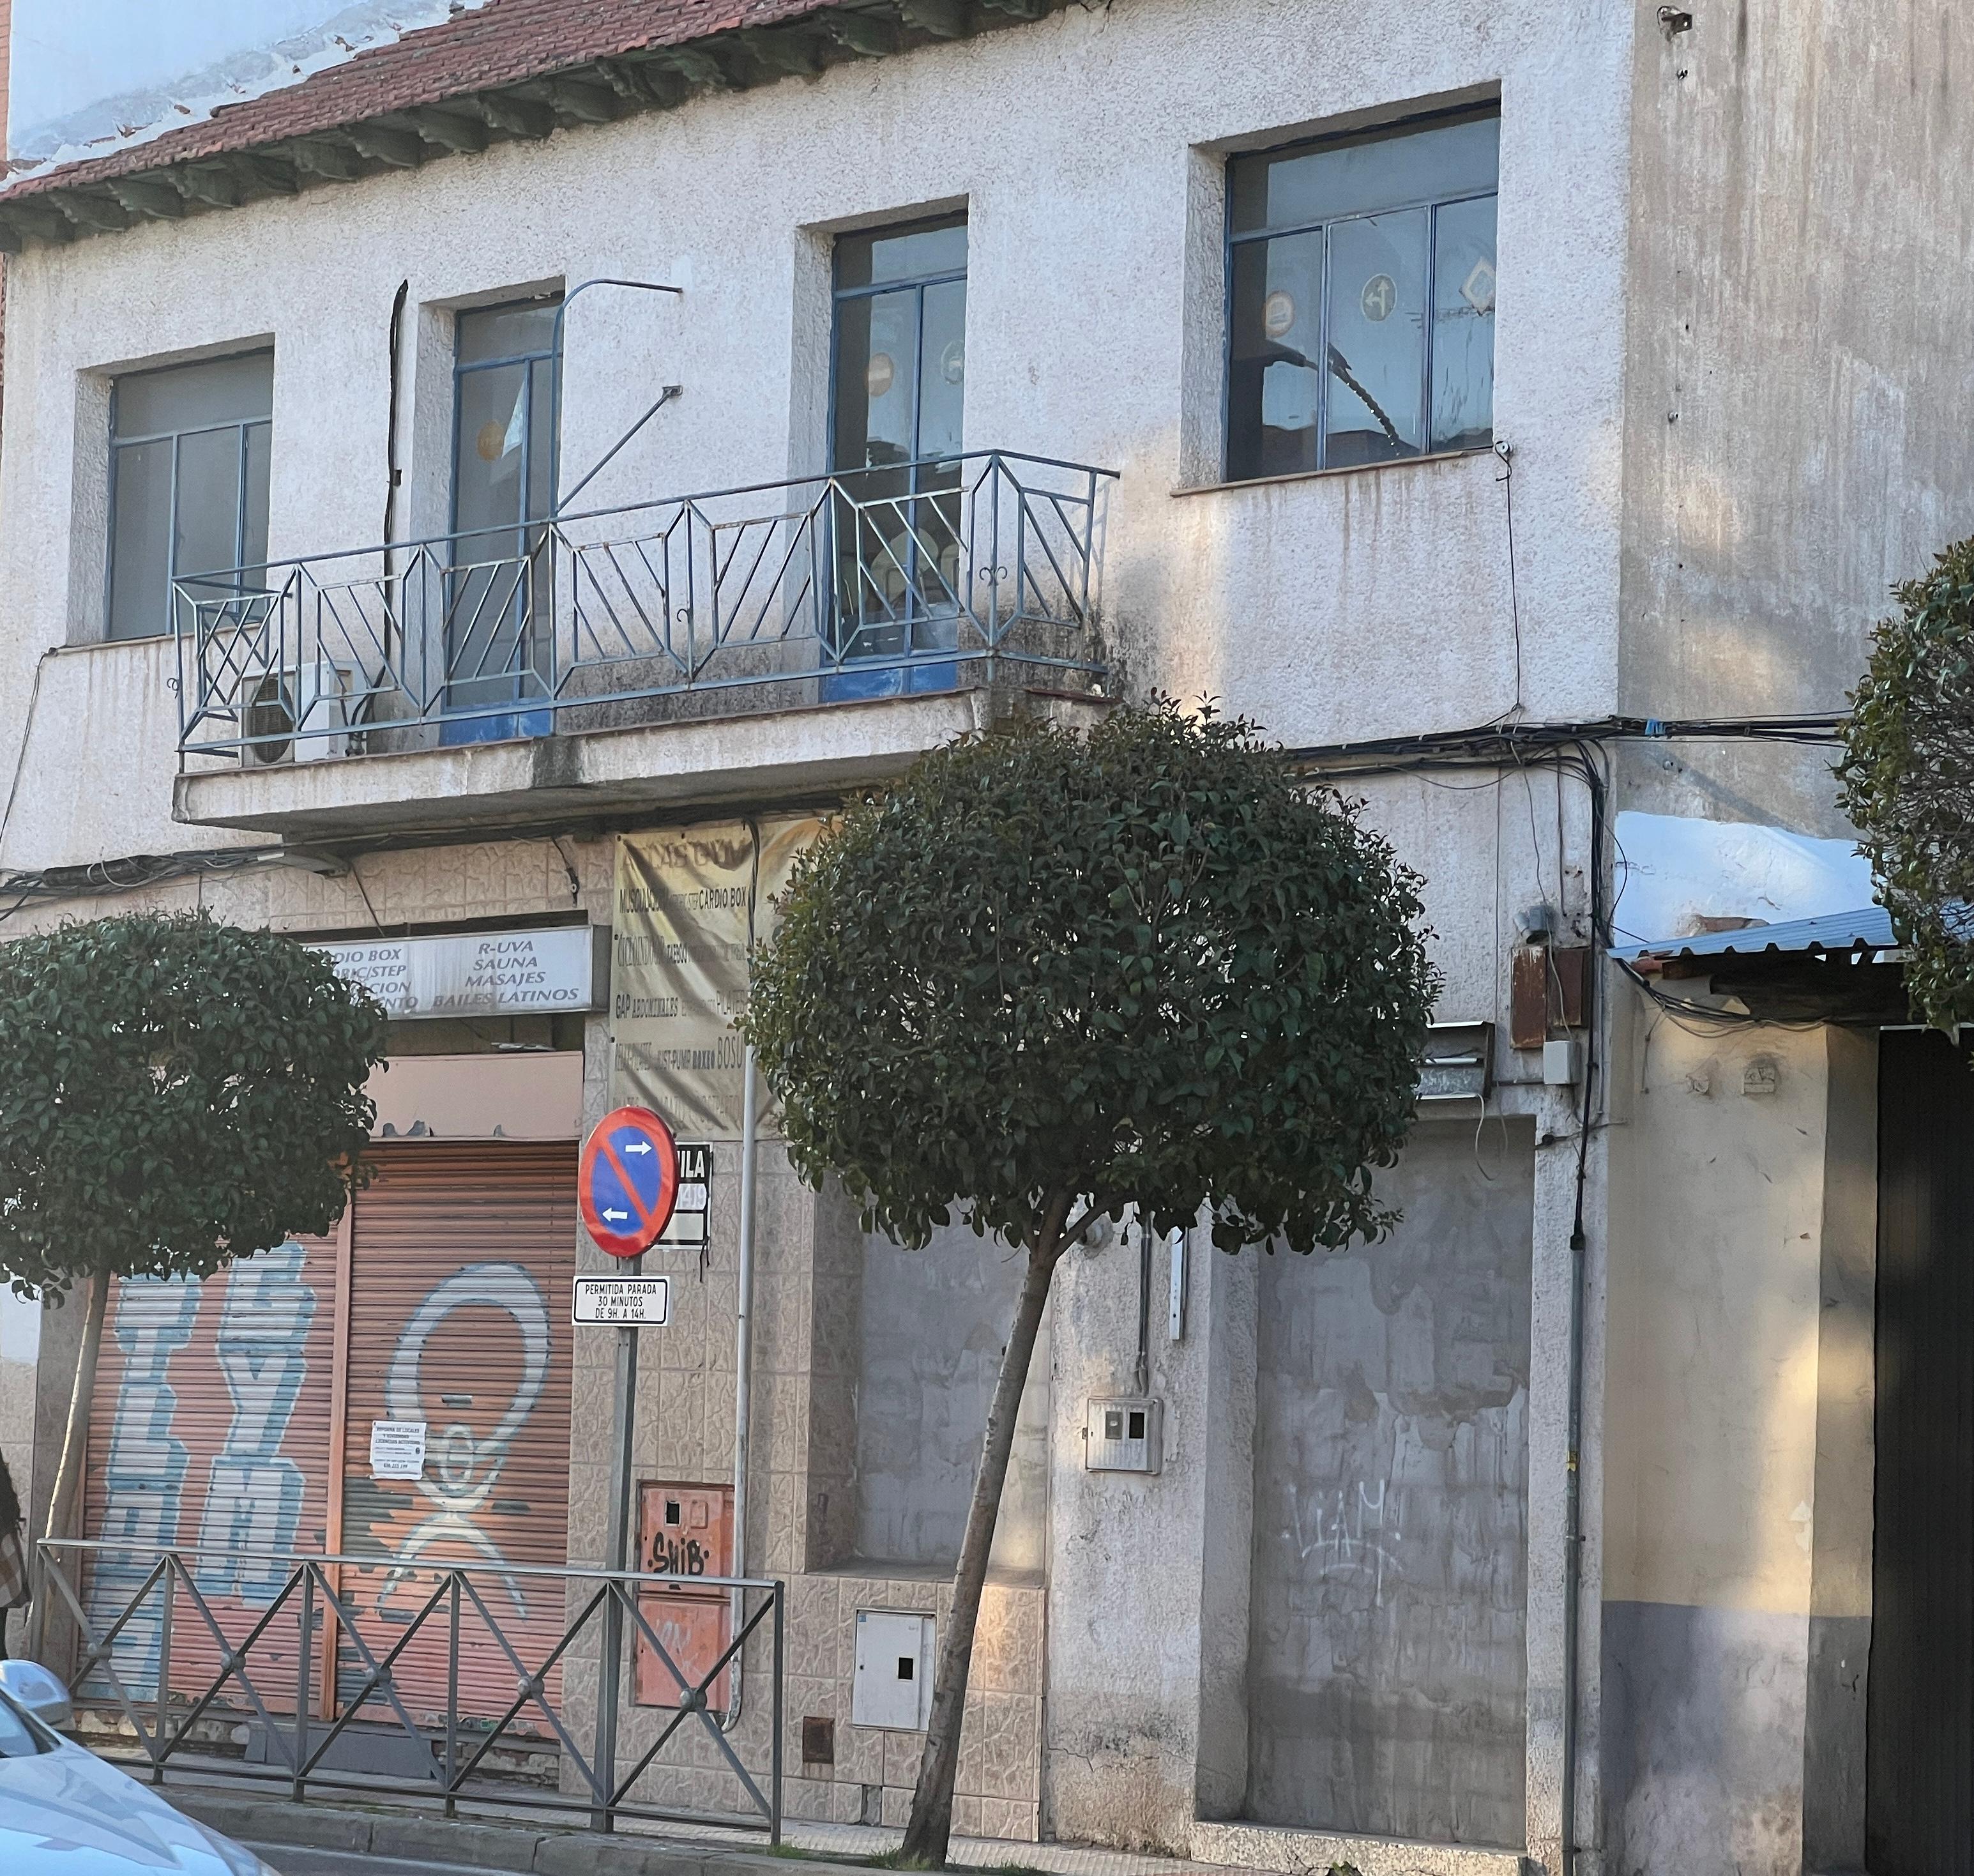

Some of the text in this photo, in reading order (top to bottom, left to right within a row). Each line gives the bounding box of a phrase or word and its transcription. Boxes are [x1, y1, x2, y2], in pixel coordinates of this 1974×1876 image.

[699, 888, 728, 910] CARDIO
[731, 886, 747, 907] BOX
[478, 940, 534, 955] R-UVA
[333, 949, 402, 963] DIO BOX
[473, 956, 538, 971] SAUNA
[370, 980, 411, 994] CION
[465, 972, 547, 987] MASAJES
[433, 988, 579, 1007] BAILES LATINOS
[616, 993, 631, 1019] GAP
[678, 1150, 705, 1178] ILA
[585, 1284, 657, 1295] PERMITIDA PARADA
[598, 1296, 643, 1307] 30 MINUTOS
[595, 1308, 605, 1319] DE
[622, 1308, 628, 1319] A
